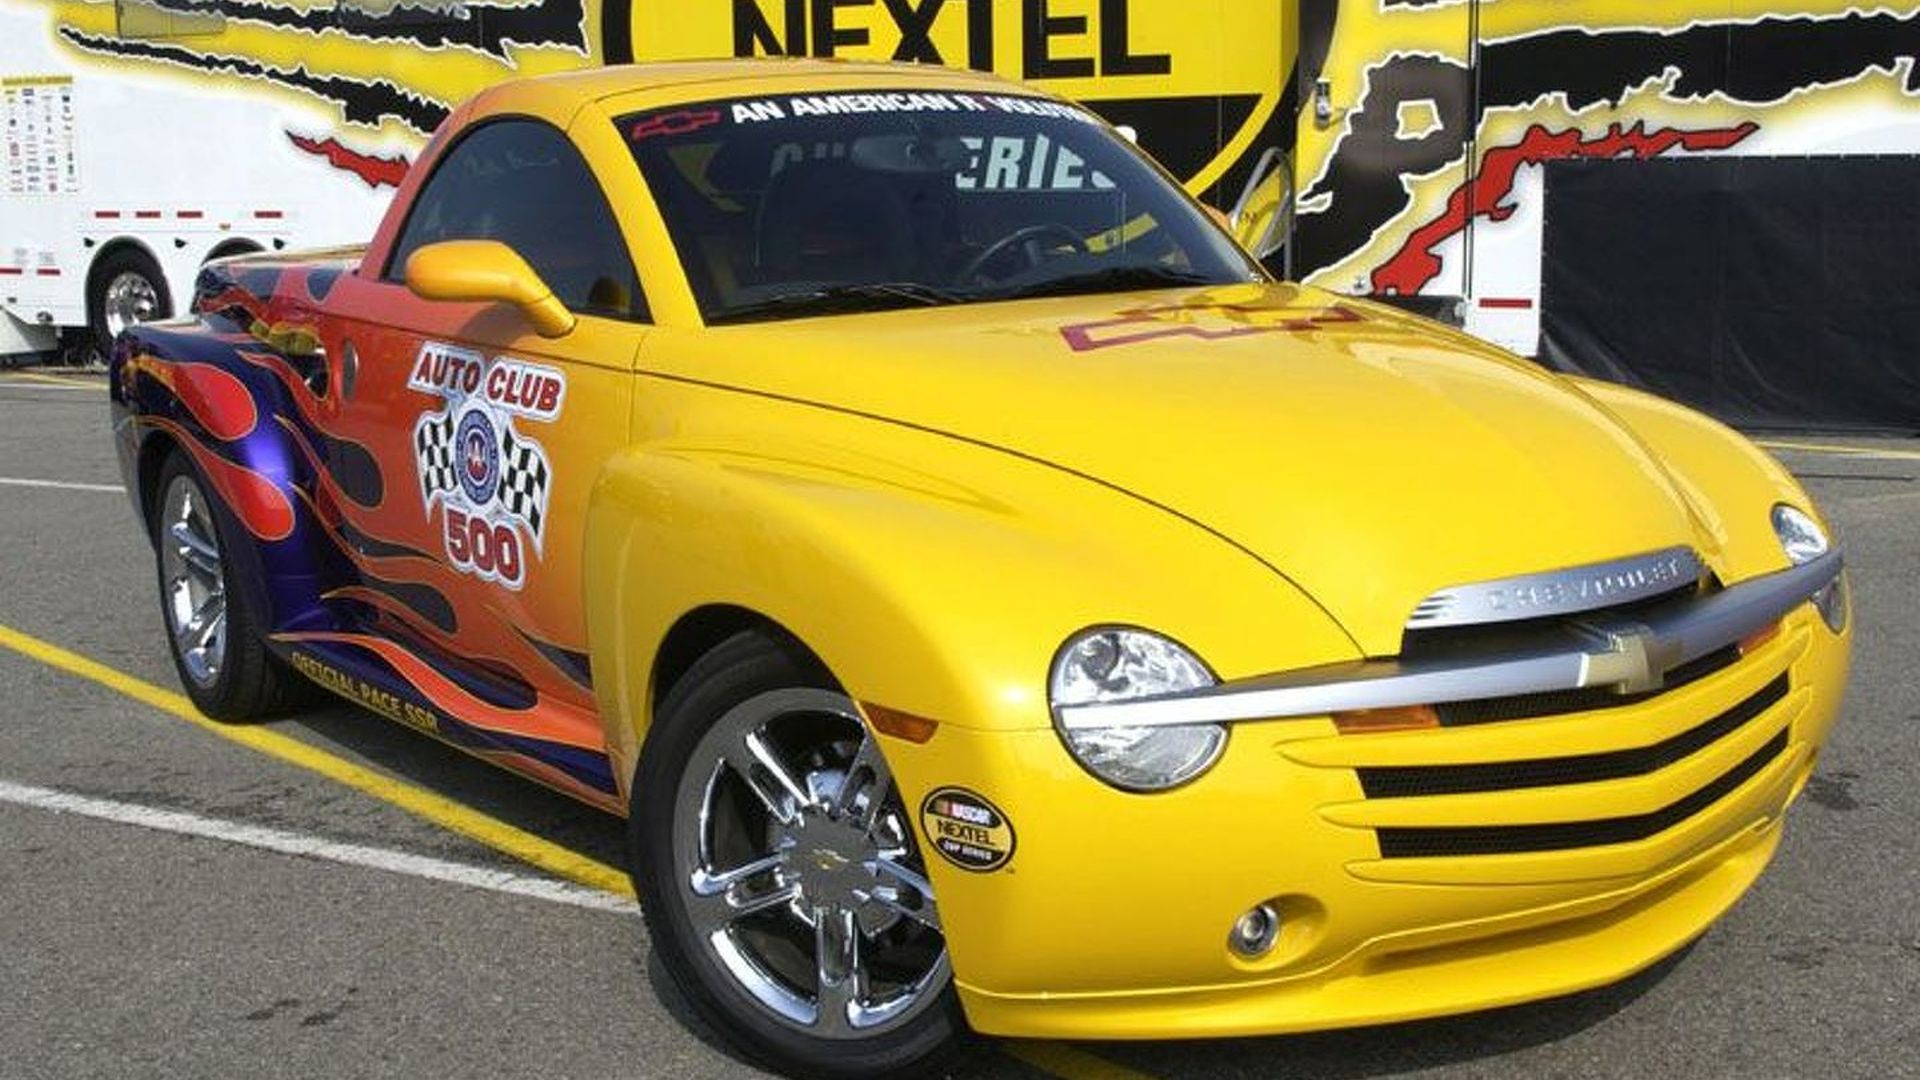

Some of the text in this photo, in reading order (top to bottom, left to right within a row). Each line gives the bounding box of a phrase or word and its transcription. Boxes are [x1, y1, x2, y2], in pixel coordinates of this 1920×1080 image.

[733, 0, 1171, 79] NEXTEL
[731, 101, 786, 125] AN
[793, 94, 958, 117] AMERICAN
[416, 352, 563, 412] AUTO CLUB
[447, 509, 521, 583] 500
